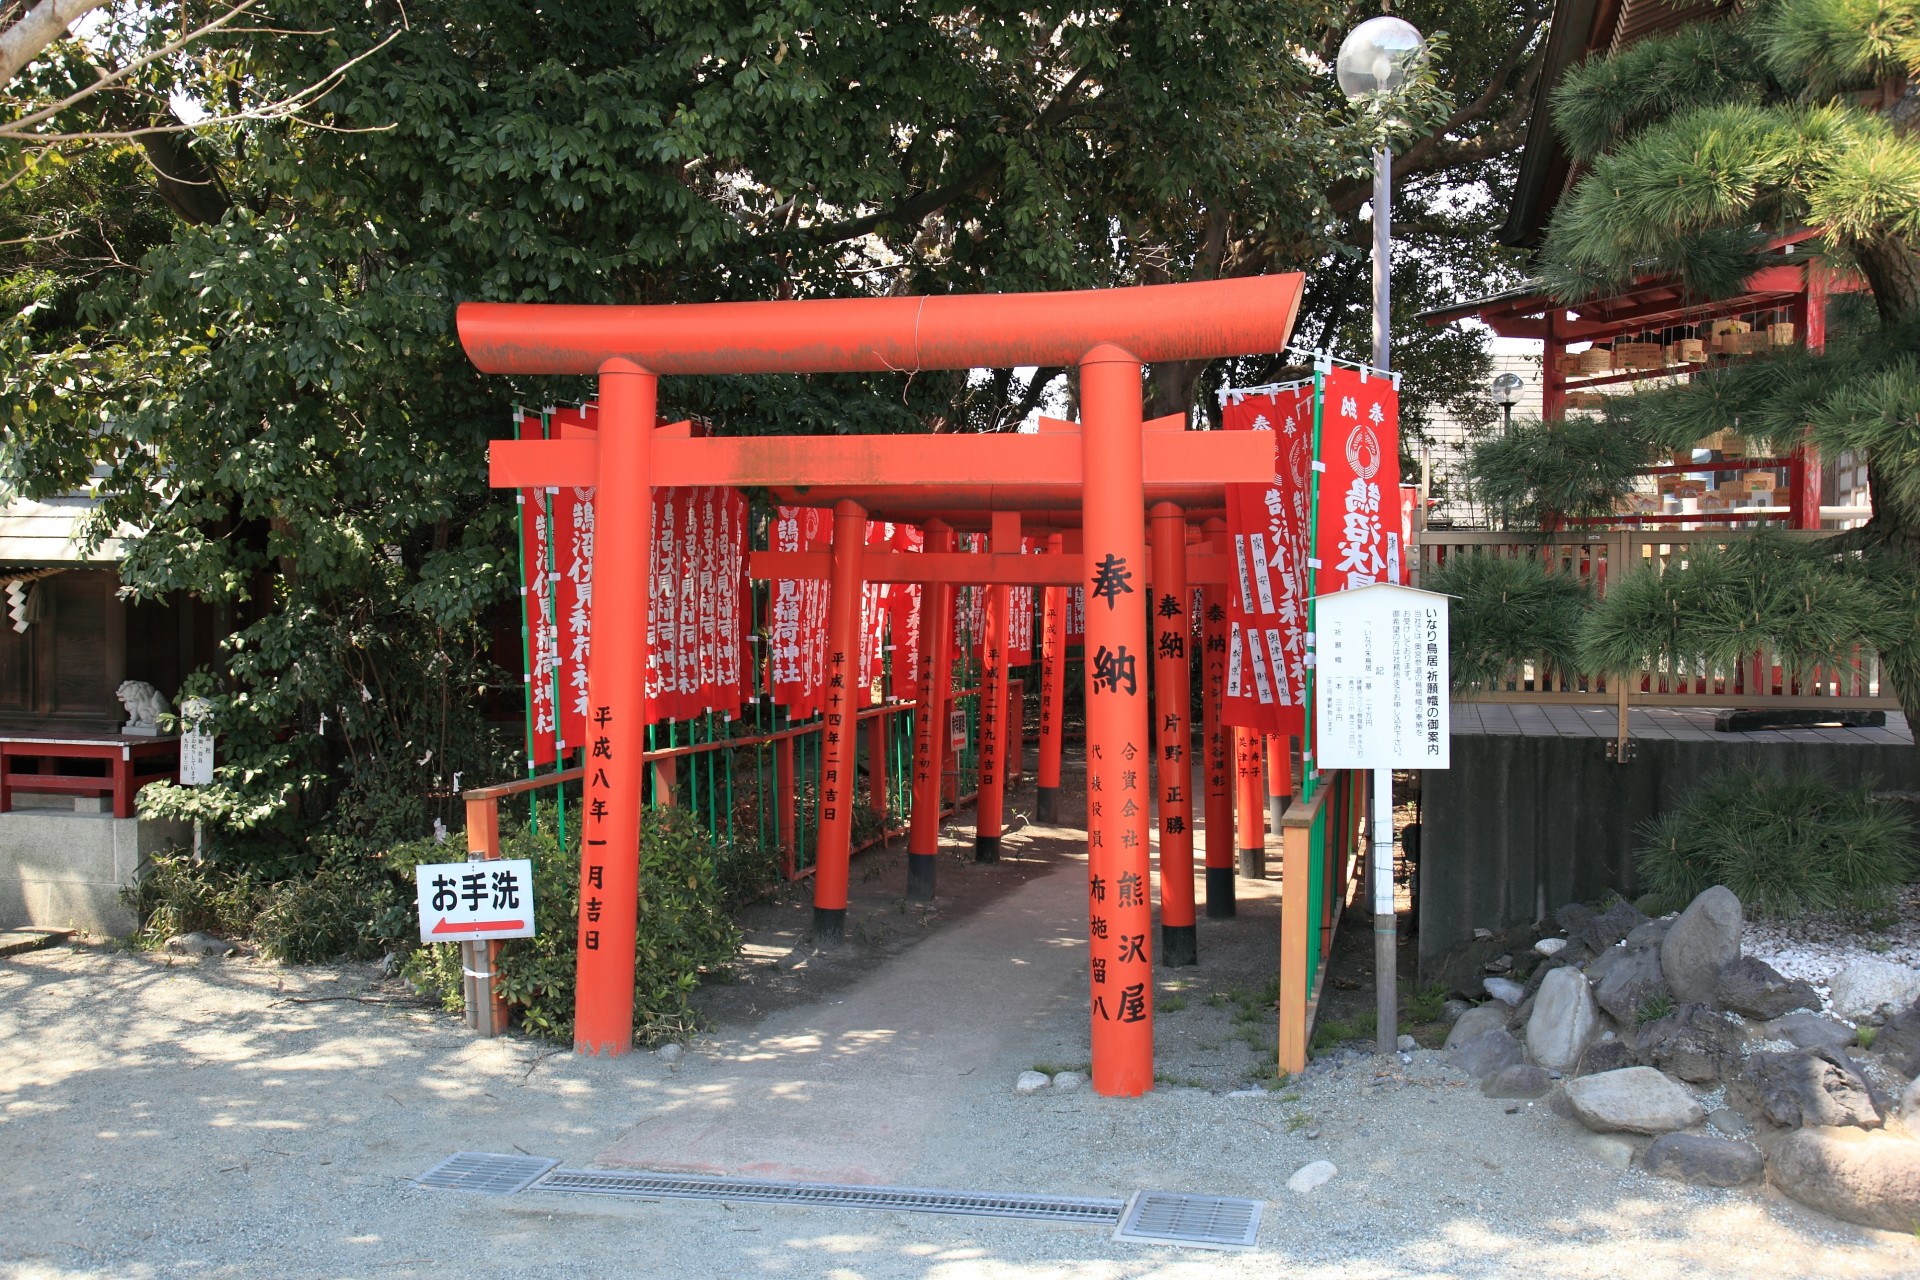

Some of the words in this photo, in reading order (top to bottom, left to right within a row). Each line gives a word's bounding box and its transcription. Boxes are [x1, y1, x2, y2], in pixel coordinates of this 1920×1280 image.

[1091, 553, 1138, 697] 奉納
[1158, 593, 1184, 659] 奉納
[1206, 603, 1226, 654] 奉納
[824, 652, 846, 821] 平成十四年二月吉日
[1091, 743, 1104, 849] 代表役員
[1121, 741, 1139, 850] 合資会社
[432, 870, 520, 912] お手洗
[586, 706, 613, 951] 平成八年一月吉日
[1090, 873, 1110, 1022] 布施留八
[1117, 870, 1148, 1024] 熊沢屋
